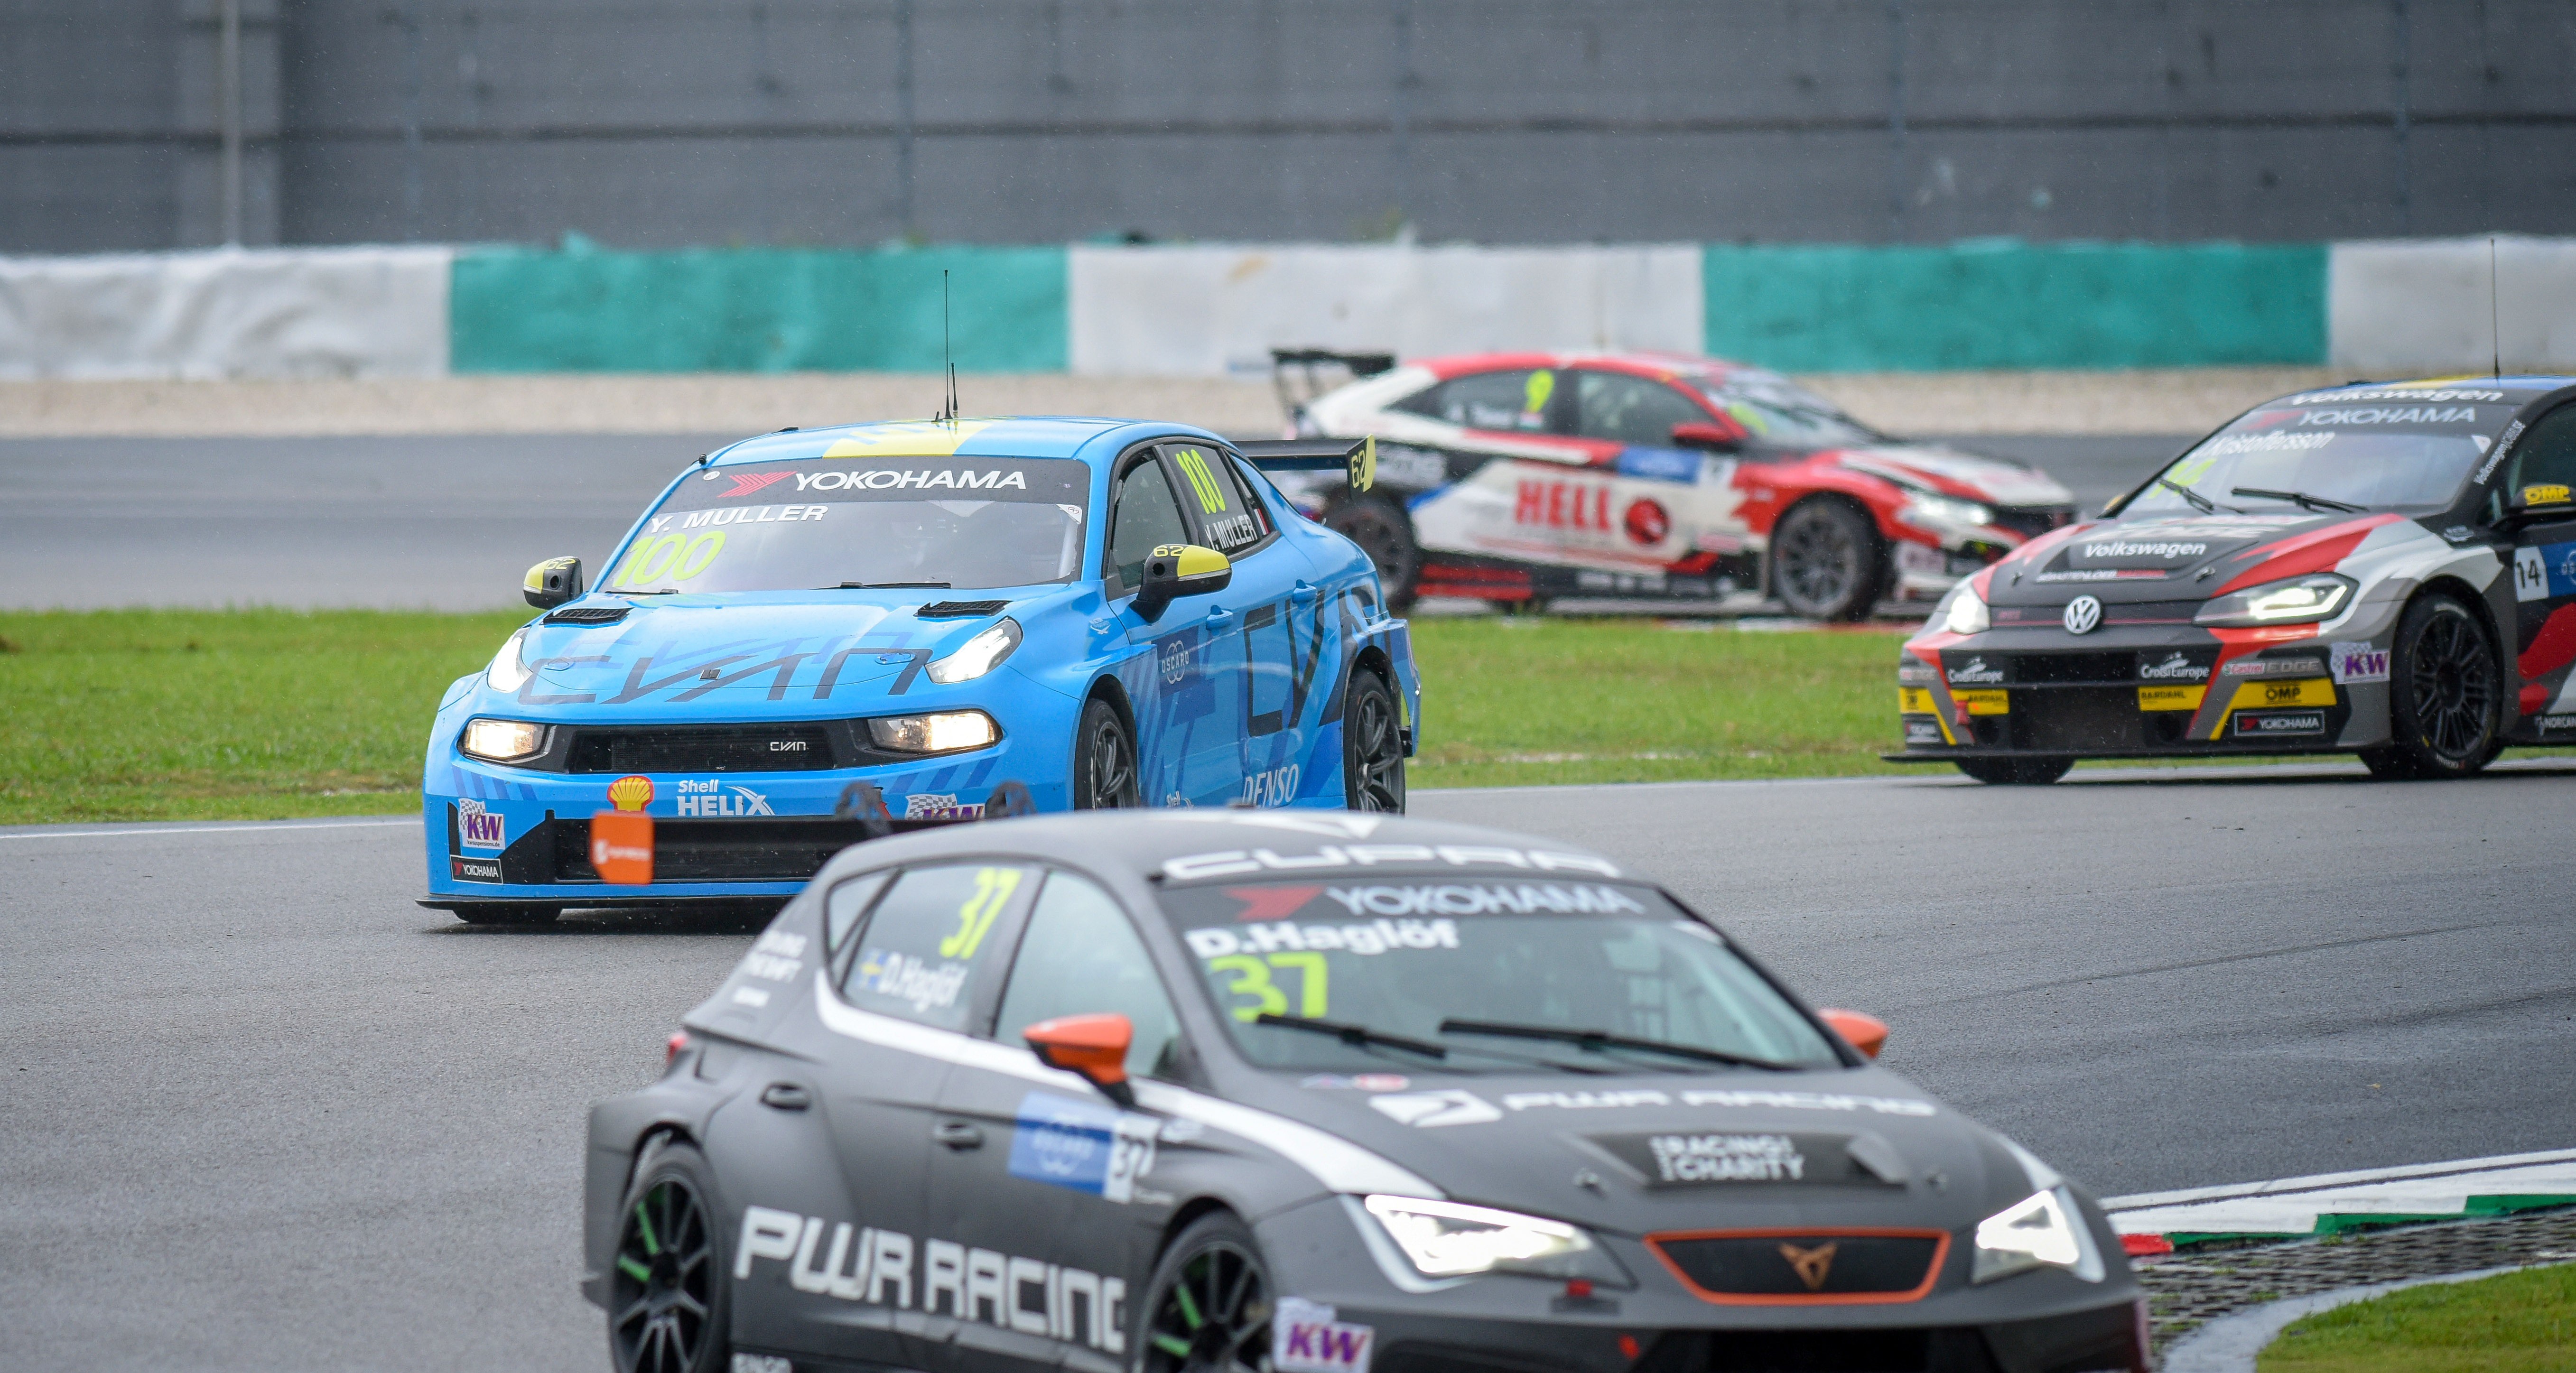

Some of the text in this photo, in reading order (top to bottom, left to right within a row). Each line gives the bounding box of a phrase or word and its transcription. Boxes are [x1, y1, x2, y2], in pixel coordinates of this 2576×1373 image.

[2298, 407, 2475, 426] YOKOHAMA
[796, 471, 1026, 491] YOKOHAMA
[1176, 449, 1226, 514] 100
[1351, 450, 1366, 488] 62
[1514, 481, 1610, 530] HELL
[2525, 488, 2570, 503] OMP
[651, 505, 828, 533] Y. MULLER
[1205, 514, 1258, 551] Y. MULLER
[545, 558, 576, 570] 62
[612, 531, 726, 588] 100
[1153, 546, 1183, 557] 62
[2085, 542, 2207, 559] Volkswagen
[2517, 559, 2540, 588] 14
[1162, 651, 1189, 673] OSCARO
[2345, 653, 2388, 675] KW
[2266, 687, 2300, 700] OMP
[2260, 717, 2319, 729] YOKOHAMA
[678, 779, 719, 793] Shell
[1242, 763, 1299, 808] DENSO
[677, 788, 775, 816] HELIX
[468, 814, 503, 841] KW
[463, 864, 499, 877] YOKOHAMA
[940, 867, 1023, 959] 37
[1326, 885, 1645, 916] YOKOHAMA
[1210, 951, 1328, 1022] 37
[734, 1205, 913, 1309] PWR
[1287, 1322, 1366, 1365] KW
